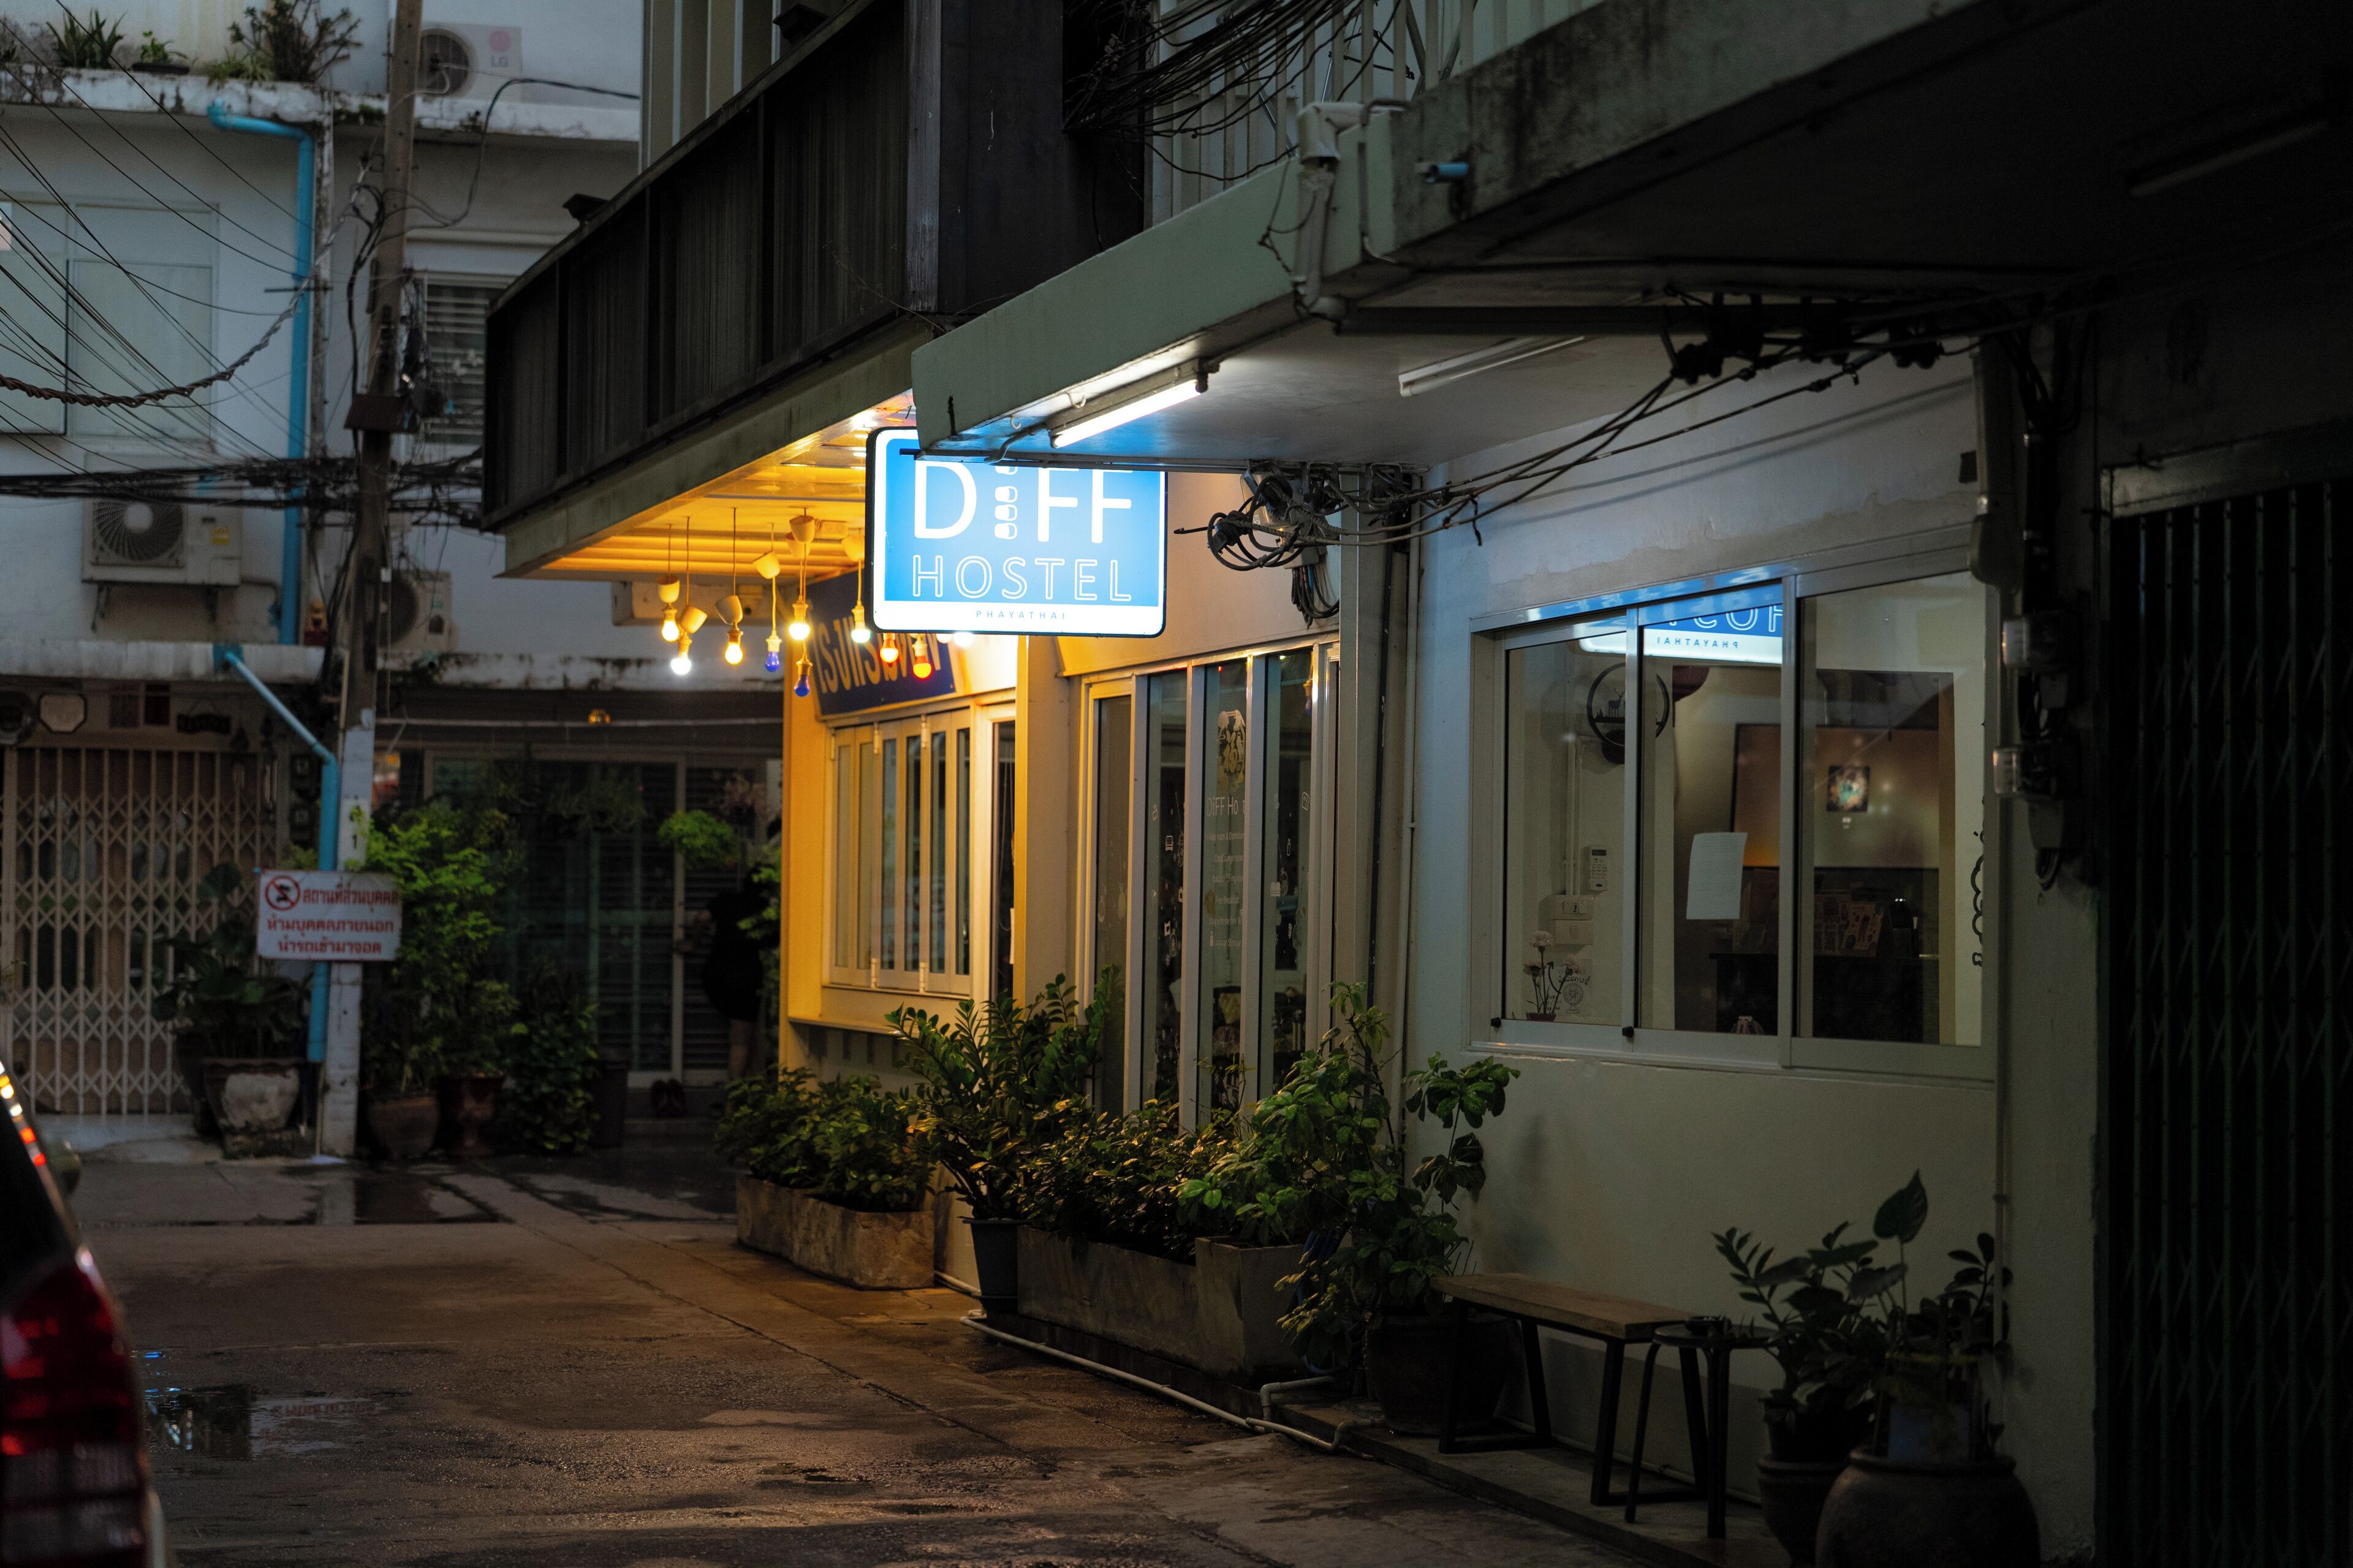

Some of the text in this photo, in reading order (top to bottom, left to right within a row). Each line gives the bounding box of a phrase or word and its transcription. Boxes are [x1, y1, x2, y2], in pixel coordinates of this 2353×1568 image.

[491, 55, 509, 67] LG
[912, 555, 1132, 602] HOSTEL
[976, 610, 1066, 619] PHAYATHAI
